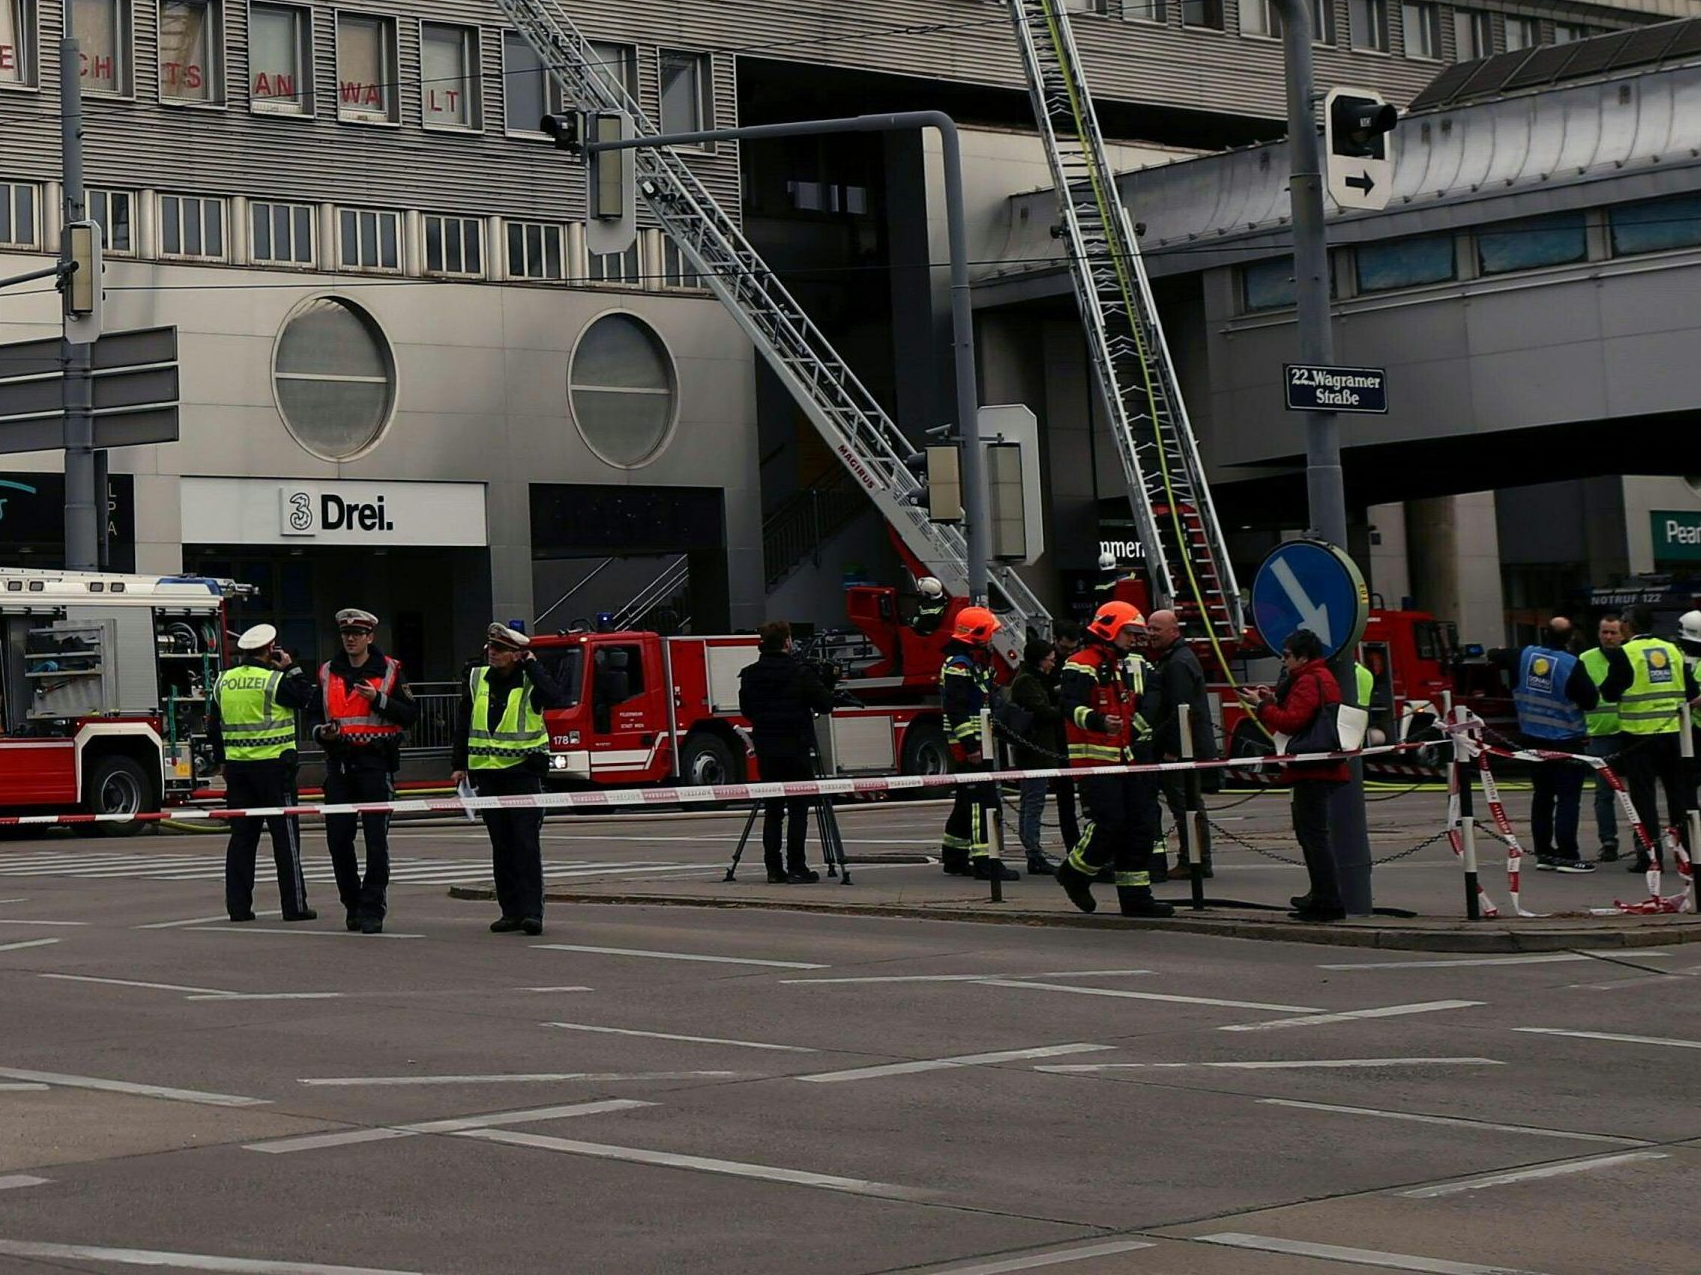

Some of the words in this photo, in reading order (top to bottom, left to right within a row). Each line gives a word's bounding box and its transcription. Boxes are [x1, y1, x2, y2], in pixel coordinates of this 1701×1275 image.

[254, 72, 294, 97] AN
[339, 80, 383, 106] WA
[429, 89, 459, 114] LT
[1312, 370, 1381, 391] Wagramer
[1315, 388, 1360, 405] Straße
[837, 444, 876, 489] MAGIRUS
[321, 494, 394, 531] Drei.
[1590, 594, 1638, 606] NOTRUF
[1642, 593, 1662, 604] 122
[221, 677, 266, 691] POLIZEI
[553, 735, 569, 745] 178
